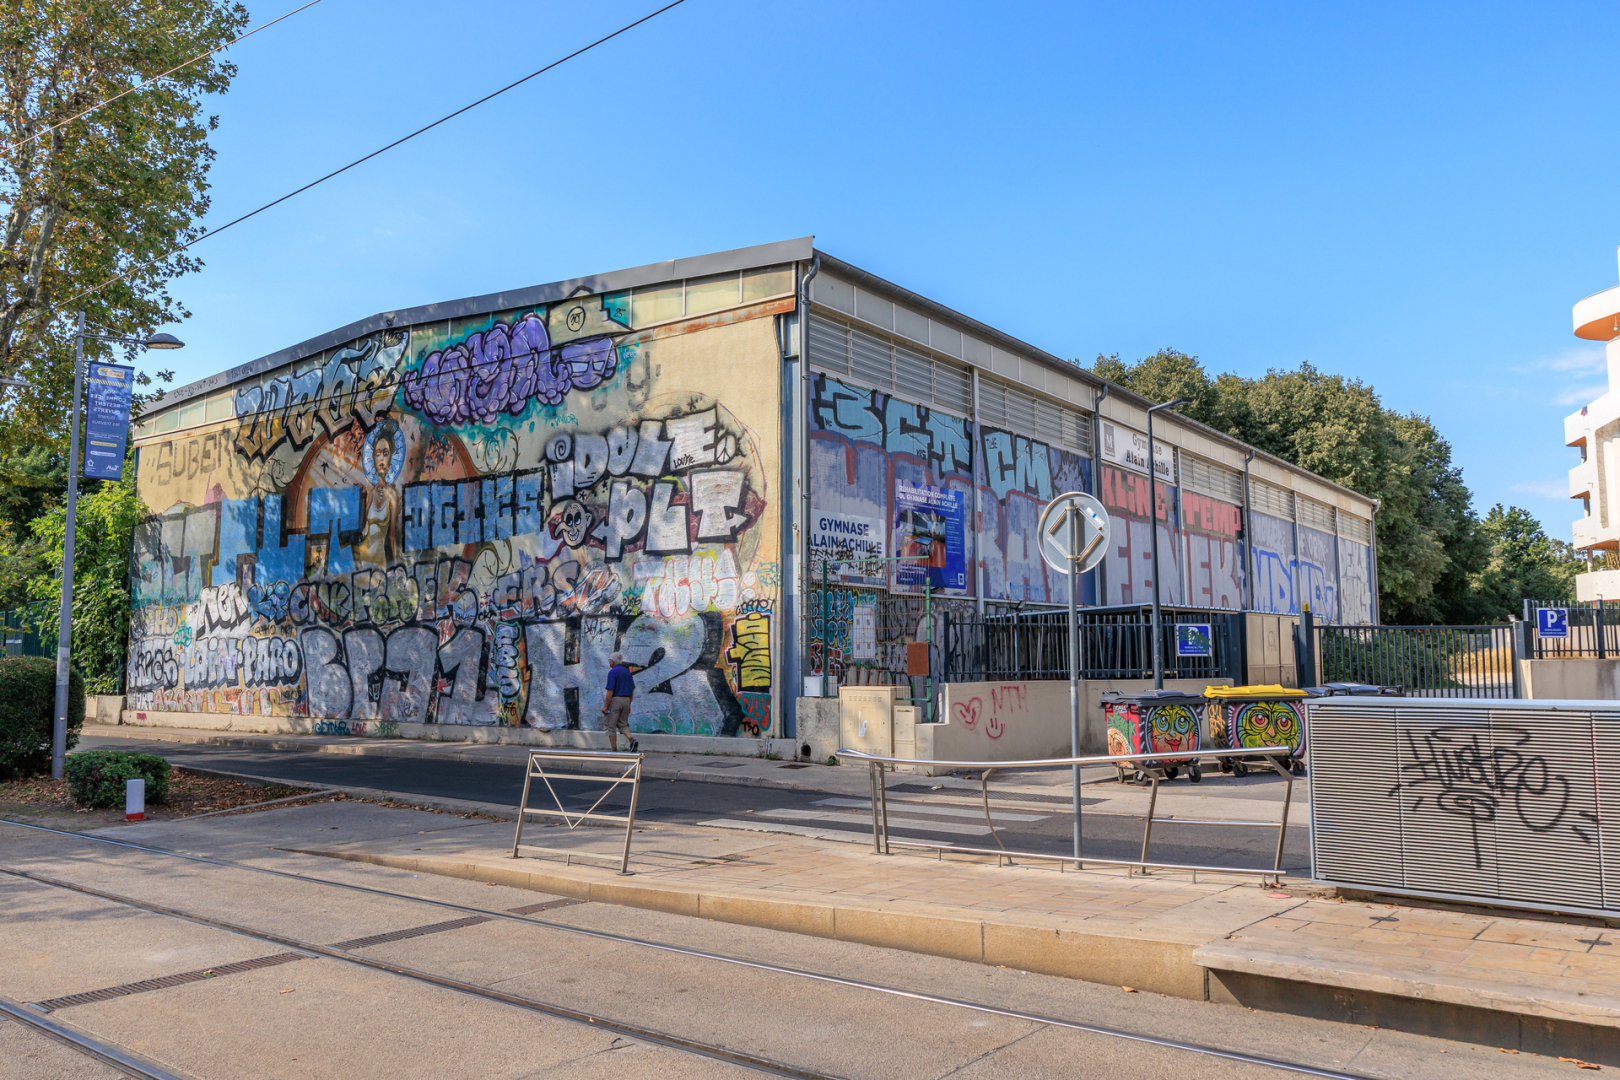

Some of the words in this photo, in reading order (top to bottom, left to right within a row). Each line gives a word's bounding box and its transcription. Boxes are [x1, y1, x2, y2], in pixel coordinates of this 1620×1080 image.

[1132, 433, 1162, 456] Gymse
[1126, 450, 1145, 468] Alain
[1147, 457, 1169, 477] Ahille
[819, 517, 869, 537] GYMNASE
[841, 537, 882, 555] ACHILLE
[1546, 610, 1558, 628] P
